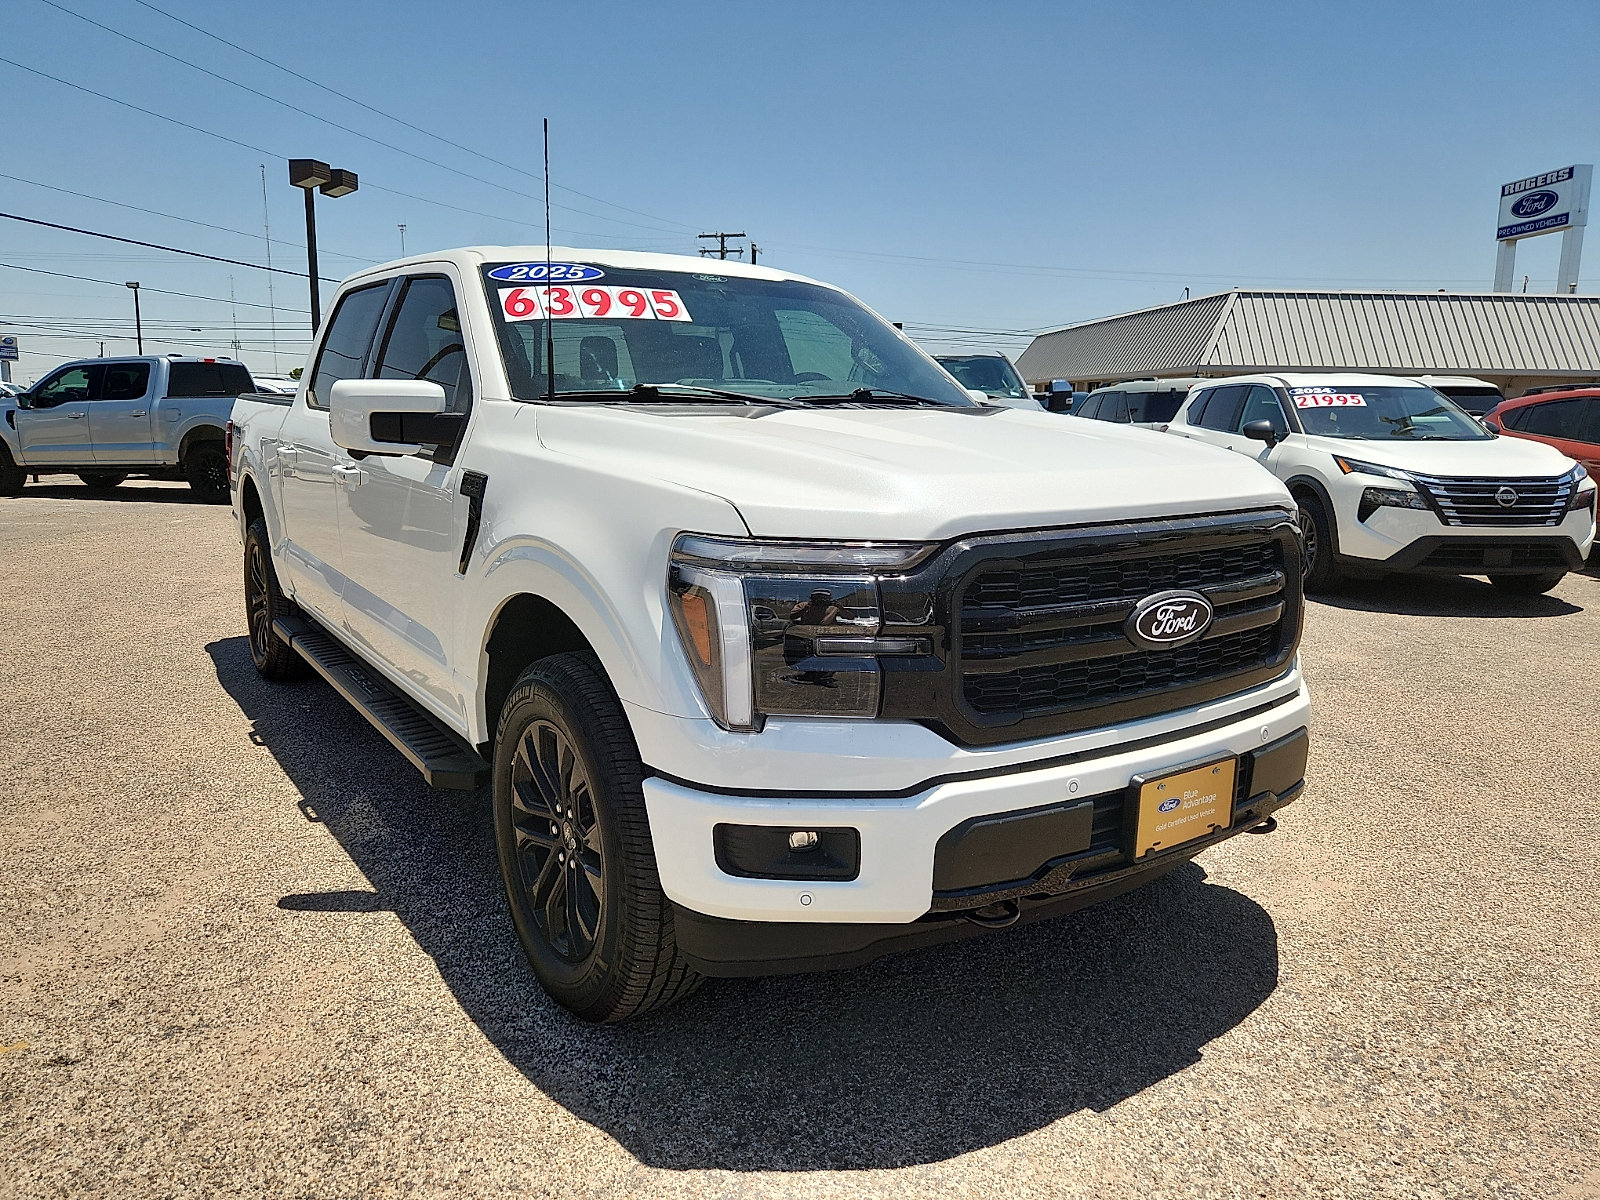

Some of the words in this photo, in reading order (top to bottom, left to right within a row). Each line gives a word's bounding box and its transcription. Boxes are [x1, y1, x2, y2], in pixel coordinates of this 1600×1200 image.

[1504, 168, 1569, 195] ROGERS
[1519, 195, 1548, 214] Ford
[1498, 223, 1535, 237] PRE-OWNED
[1535, 216, 1567, 228] VEHICLES
[509, 266, 585, 280] 2025
[504, 287, 681, 318] 63995
[1294, 387, 1331, 395] 2024
[1296, 395, 1361, 407] 21995
[1151, 604, 1198, 636] Ford
[1182, 793, 1217, 810] Advantage
[1183, 789, 1199, 800] Blue
[1161, 799, 1178, 812] Ford
[1155, 823, 1167, 832] Gold
[1167, 816, 1187, 828] Certified
[1187, 812, 1199, 822] Used
[1199, 808, 1216, 818] Vehicle
